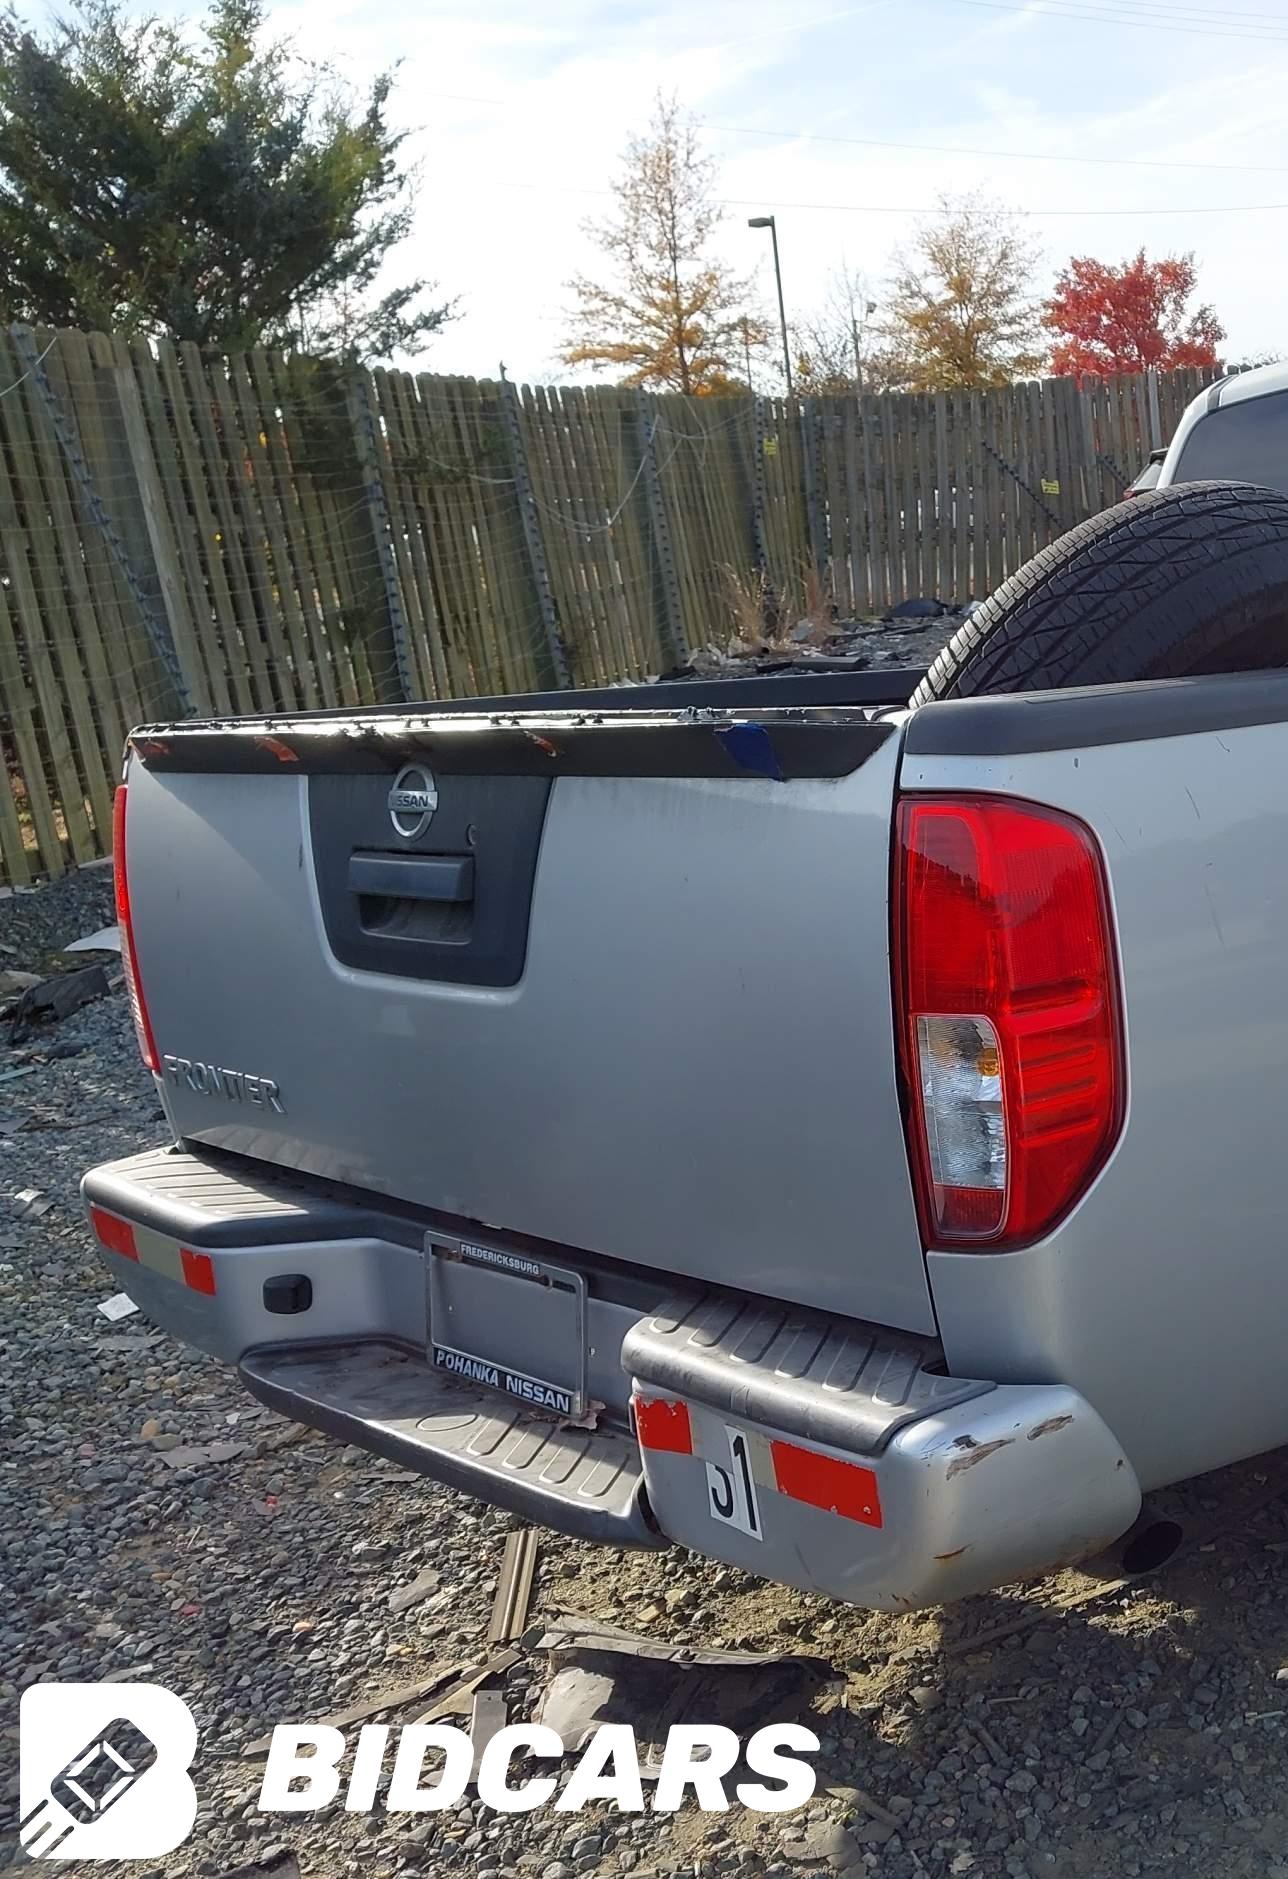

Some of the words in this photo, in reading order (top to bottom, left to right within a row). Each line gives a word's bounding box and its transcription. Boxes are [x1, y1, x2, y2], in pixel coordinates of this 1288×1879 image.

[389, 795, 429, 807] SSAN
[163, 1054, 286, 1113] FRONTIER
[461, 1244, 540, 1275] FREDERICKSBURG
[436, 1350, 499, 1387] POHANKA
[506, 1375, 570, 1413] NISSAN
